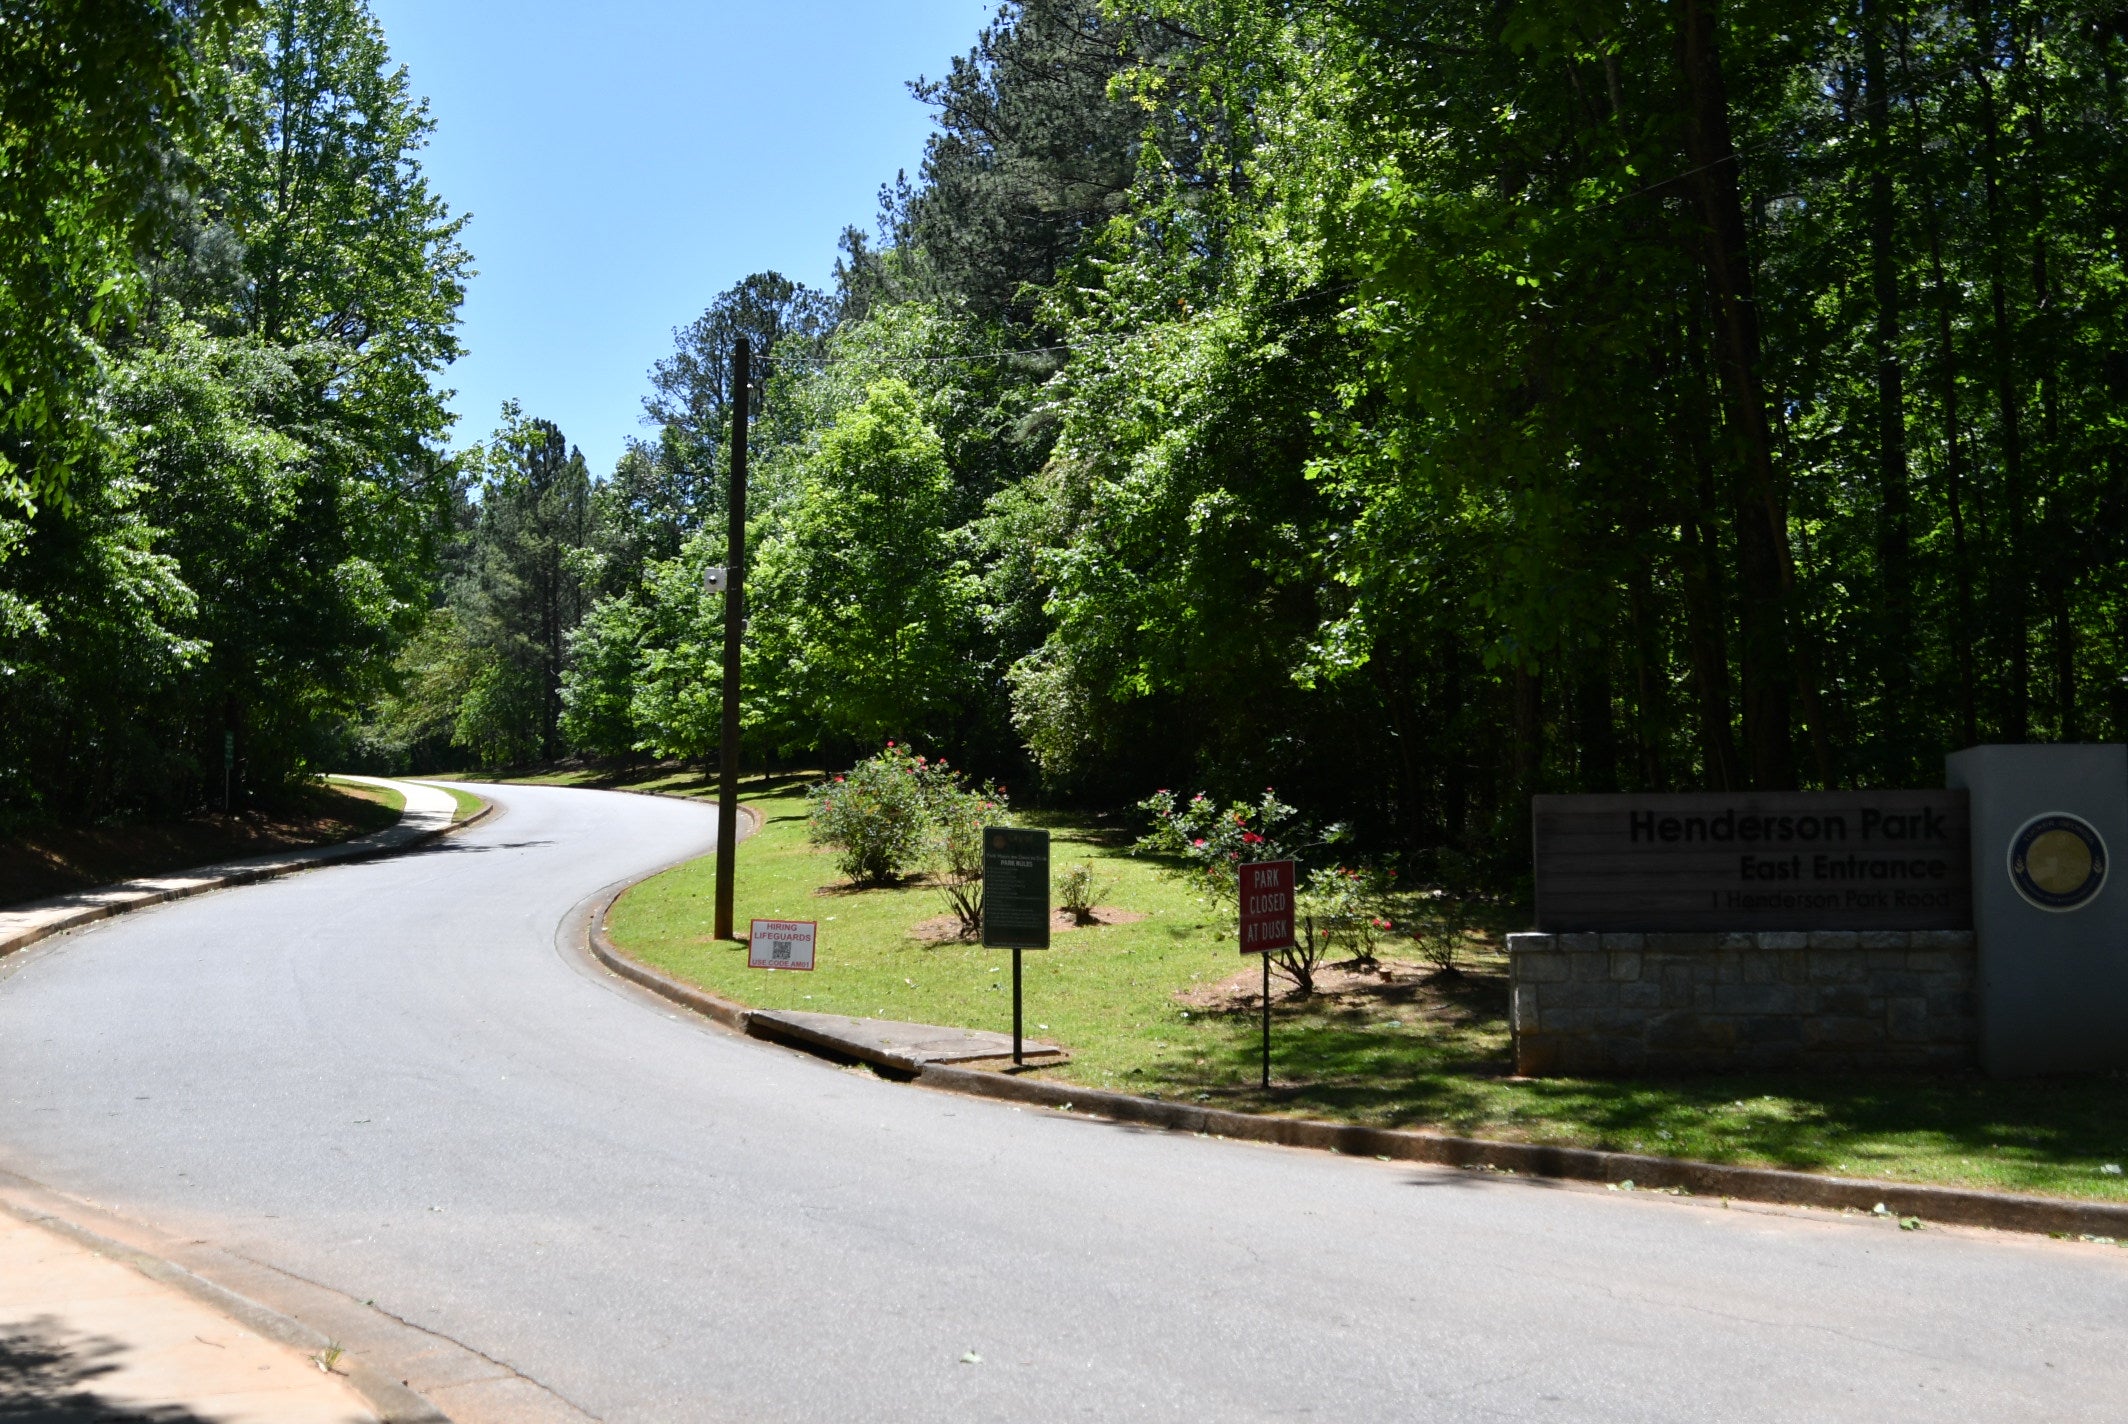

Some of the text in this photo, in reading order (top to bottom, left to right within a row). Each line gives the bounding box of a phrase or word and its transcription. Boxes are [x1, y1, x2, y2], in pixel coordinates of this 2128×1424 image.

[1629, 806, 1948, 842] Henderson Park
[1000, 859, 1015, 867] PARK
[1741, 854, 1948, 880] East Entrance
[1254, 869, 1279, 888] PARK
[1250, 893, 1285, 914] CLOSED
[1728, 889, 1840, 908] Henderson
[1846, 889, 1888, 908] Park
[1894, 888, 1951, 907] Road
[754, 933, 811, 941] LIFEGUARDS
[767, 923, 798, 931] HIRING
[1248, 921, 1287, 942] AT DUSK
